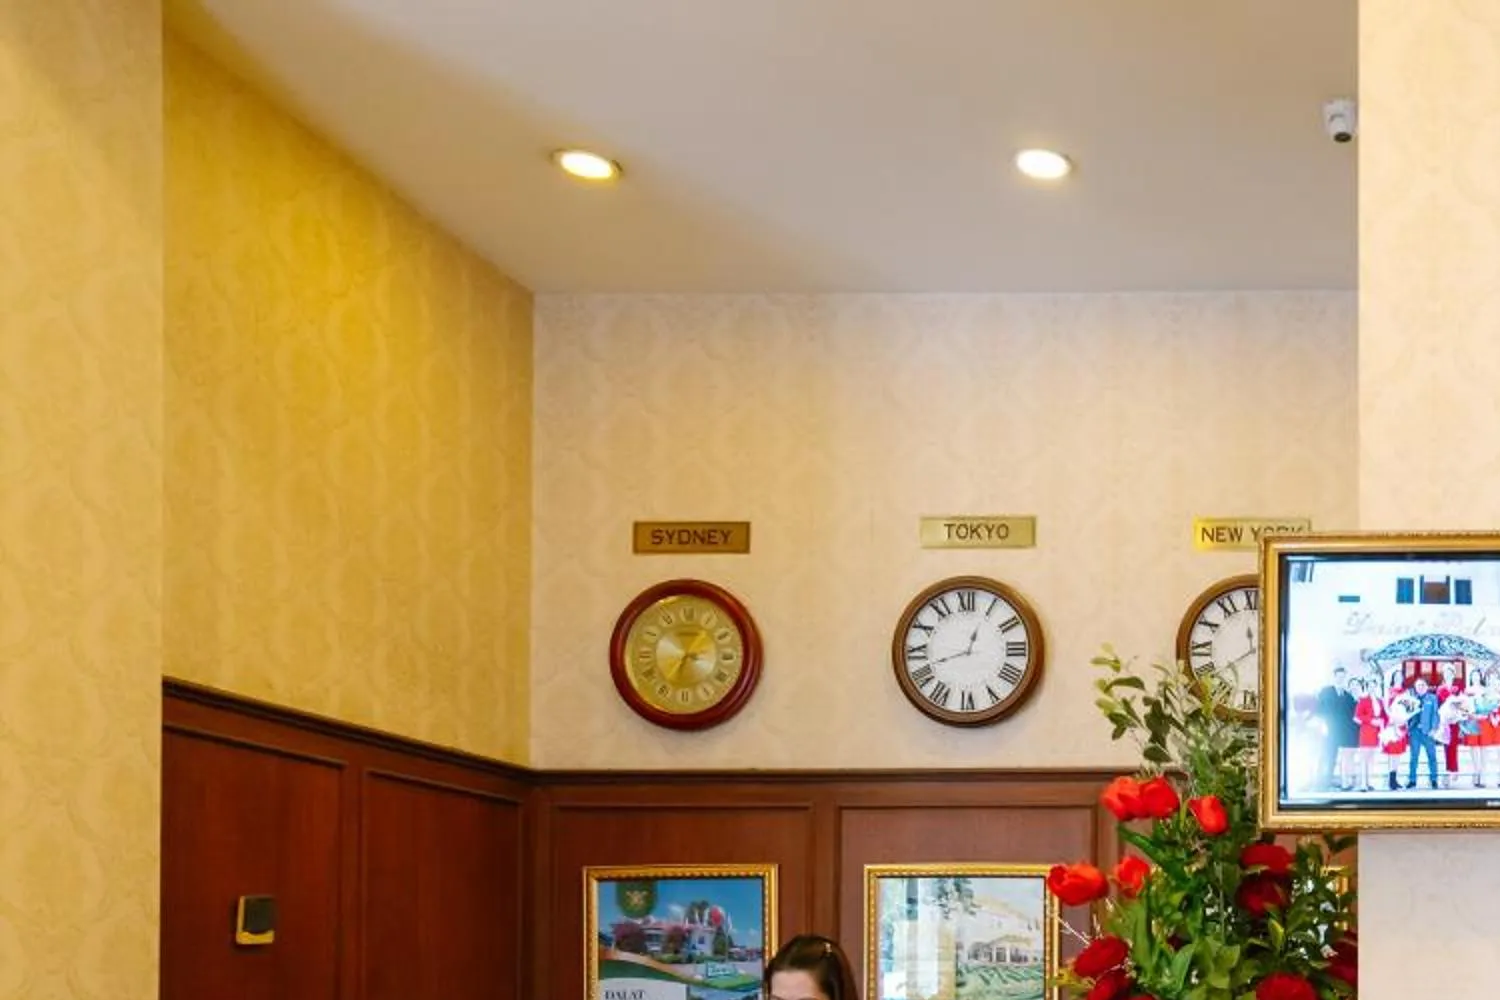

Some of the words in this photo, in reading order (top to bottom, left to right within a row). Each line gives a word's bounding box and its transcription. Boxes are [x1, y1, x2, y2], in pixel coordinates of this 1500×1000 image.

[651, 529, 733, 545] SYDNEY
[943, 523, 1010, 540] TOKYO
[1201, 527, 1243, 543] NEW
[605, 989, 646, 1000] DALAT
